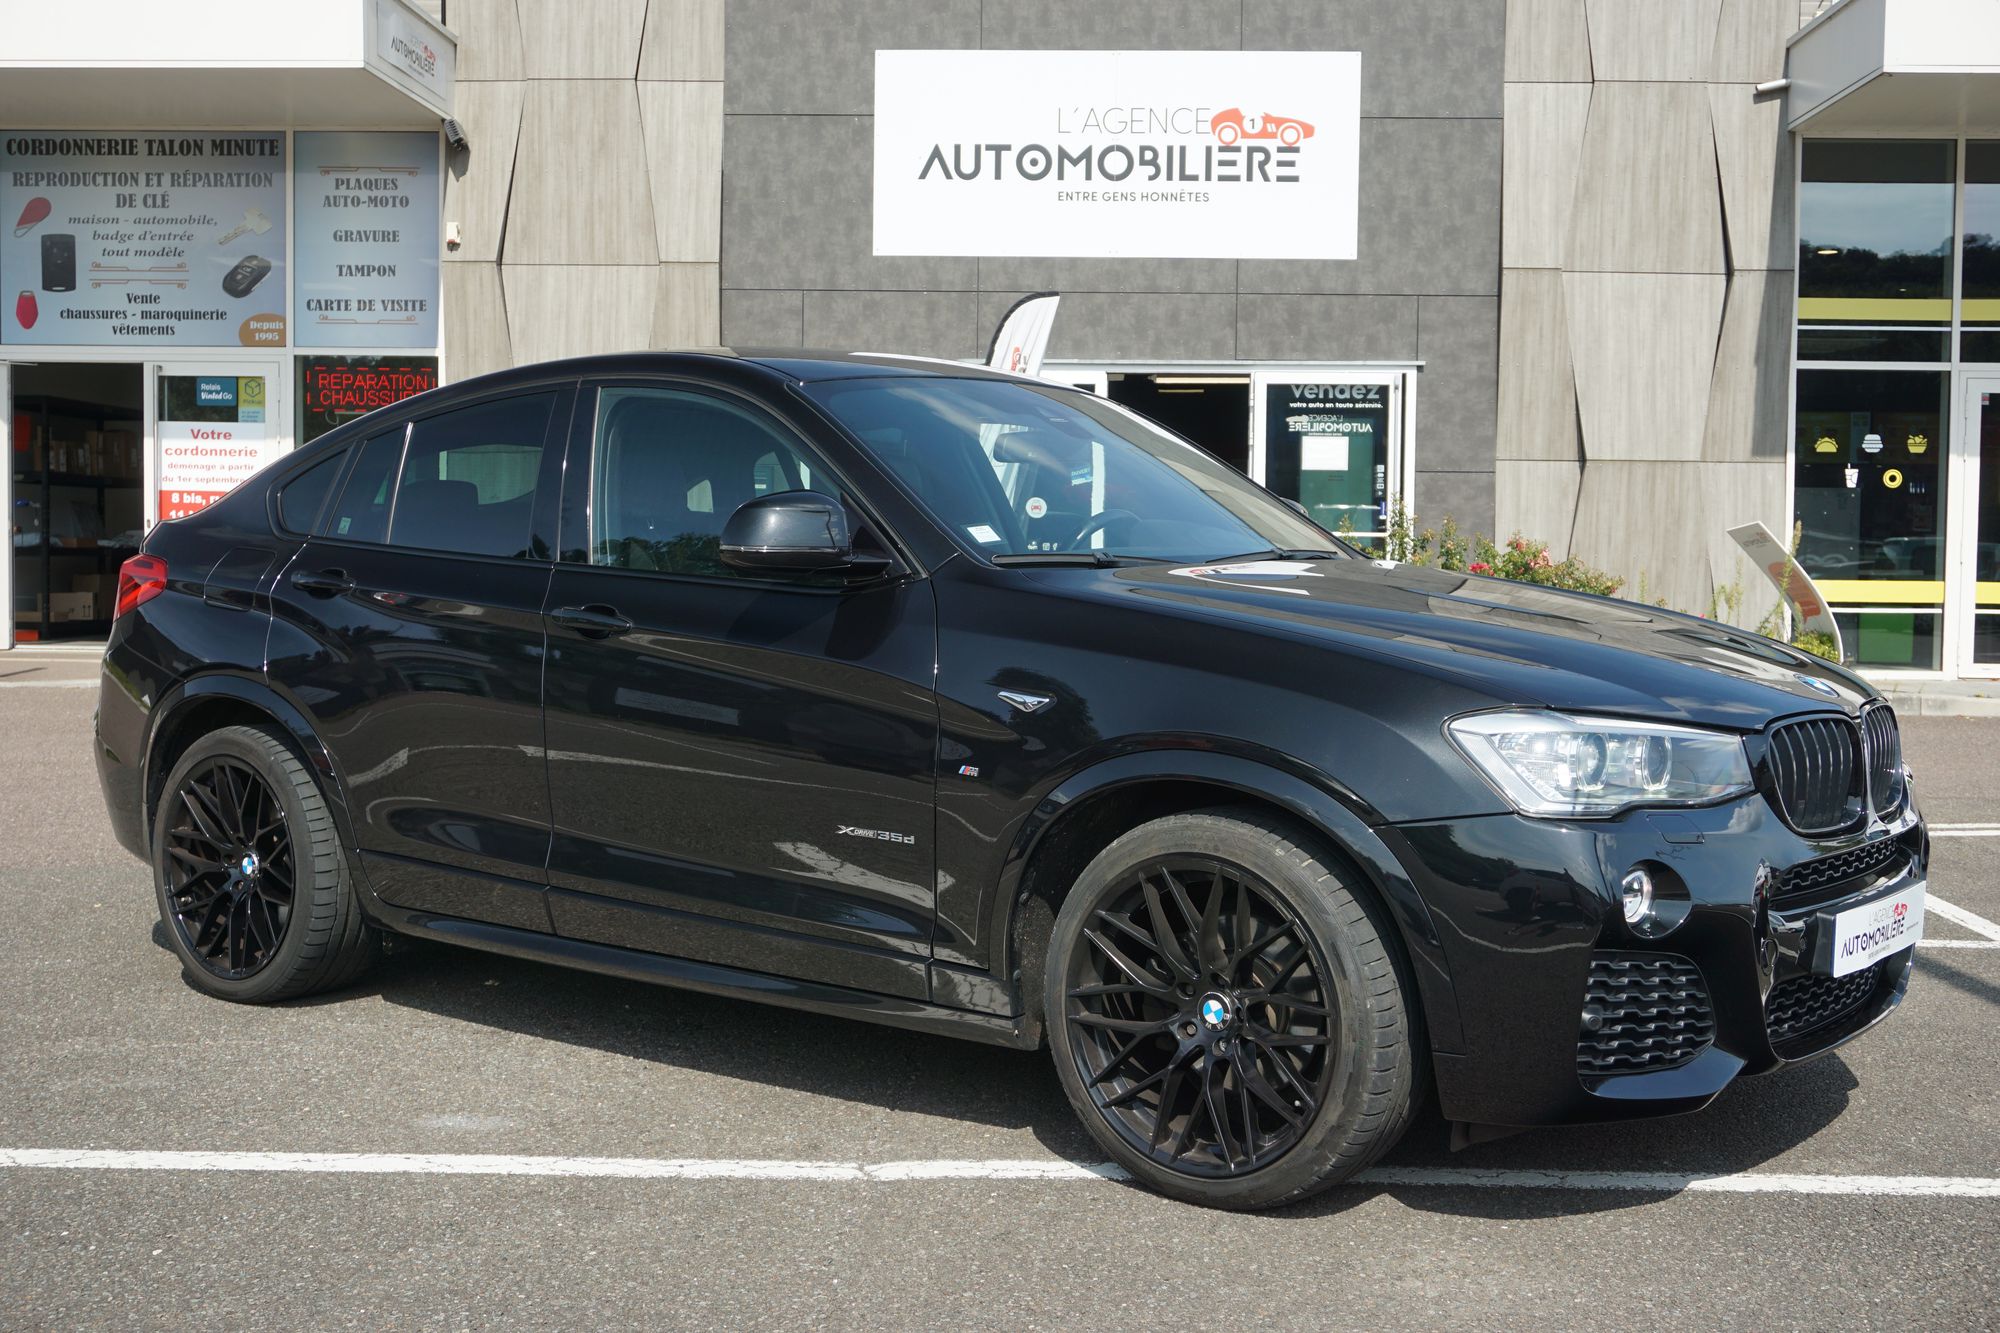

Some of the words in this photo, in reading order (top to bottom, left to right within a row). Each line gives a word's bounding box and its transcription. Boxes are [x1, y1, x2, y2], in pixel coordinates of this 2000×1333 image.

[1058, 107, 1210, 134] L'AGENCE
[1249, 118, 1256, 130] 1
[6, 138, 138, 157] CORDONNERIE
[144, 139, 204, 157] TALON
[210, 139, 279, 157] MINUTE
[918, 143, 1300, 182] AUTOMOBILIERE
[12, 171, 139, 188] REPRODUCTION
[145, 172, 164, 188] ET
[170, 169, 273, 188] RÉPARATION
[334, 178, 398, 191] PLAQUES
[115, 193, 137, 209] DE
[143, 191, 170, 209] CLÉ
[322, 195, 410, 208] AUTO-MOTO
[1058, 191, 1098, 201] ENTRE
[1102, 191, 1136, 202] GENS
[1141, 189, 1210, 202] HONNÊTES
[68, 215, 120, 226] maison
[133, 213, 218, 227] automobile,
[92, 230, 135, 243] badge
[139, 230, 194, 242] d'entrée
[333, 230, 400, 243] GRAVURE
[101, 247, 130, 258] tout
[134, 246, 185, 258] modèle
[336, 264, 396, 277] TAMPON
[126, 292, 161, 304] Vente
[306, 298, 352, 312] CARTE
[357, 299, 376, 312] DE
[381, 299, 427, 312] VISITE
[60, 307, 128, 320] chaussures
[140, 309, 228, 322] maroquinerie
[112, 323, 175, 336] vêtements
[250, 320, 284, 332] Depuis
[254, 331, 279, 341] 1995
[201, 383, 221, 391] Relais
[318, 373, 428, 390] REPARATION
[201, 391, 222, 400] Vinted
[223, 392, 233, 400] Go
[190, 429, 232, 440] Votre
[165, 446, 258, 457] cordonnerie
[228, 463, 254, 471] partir
